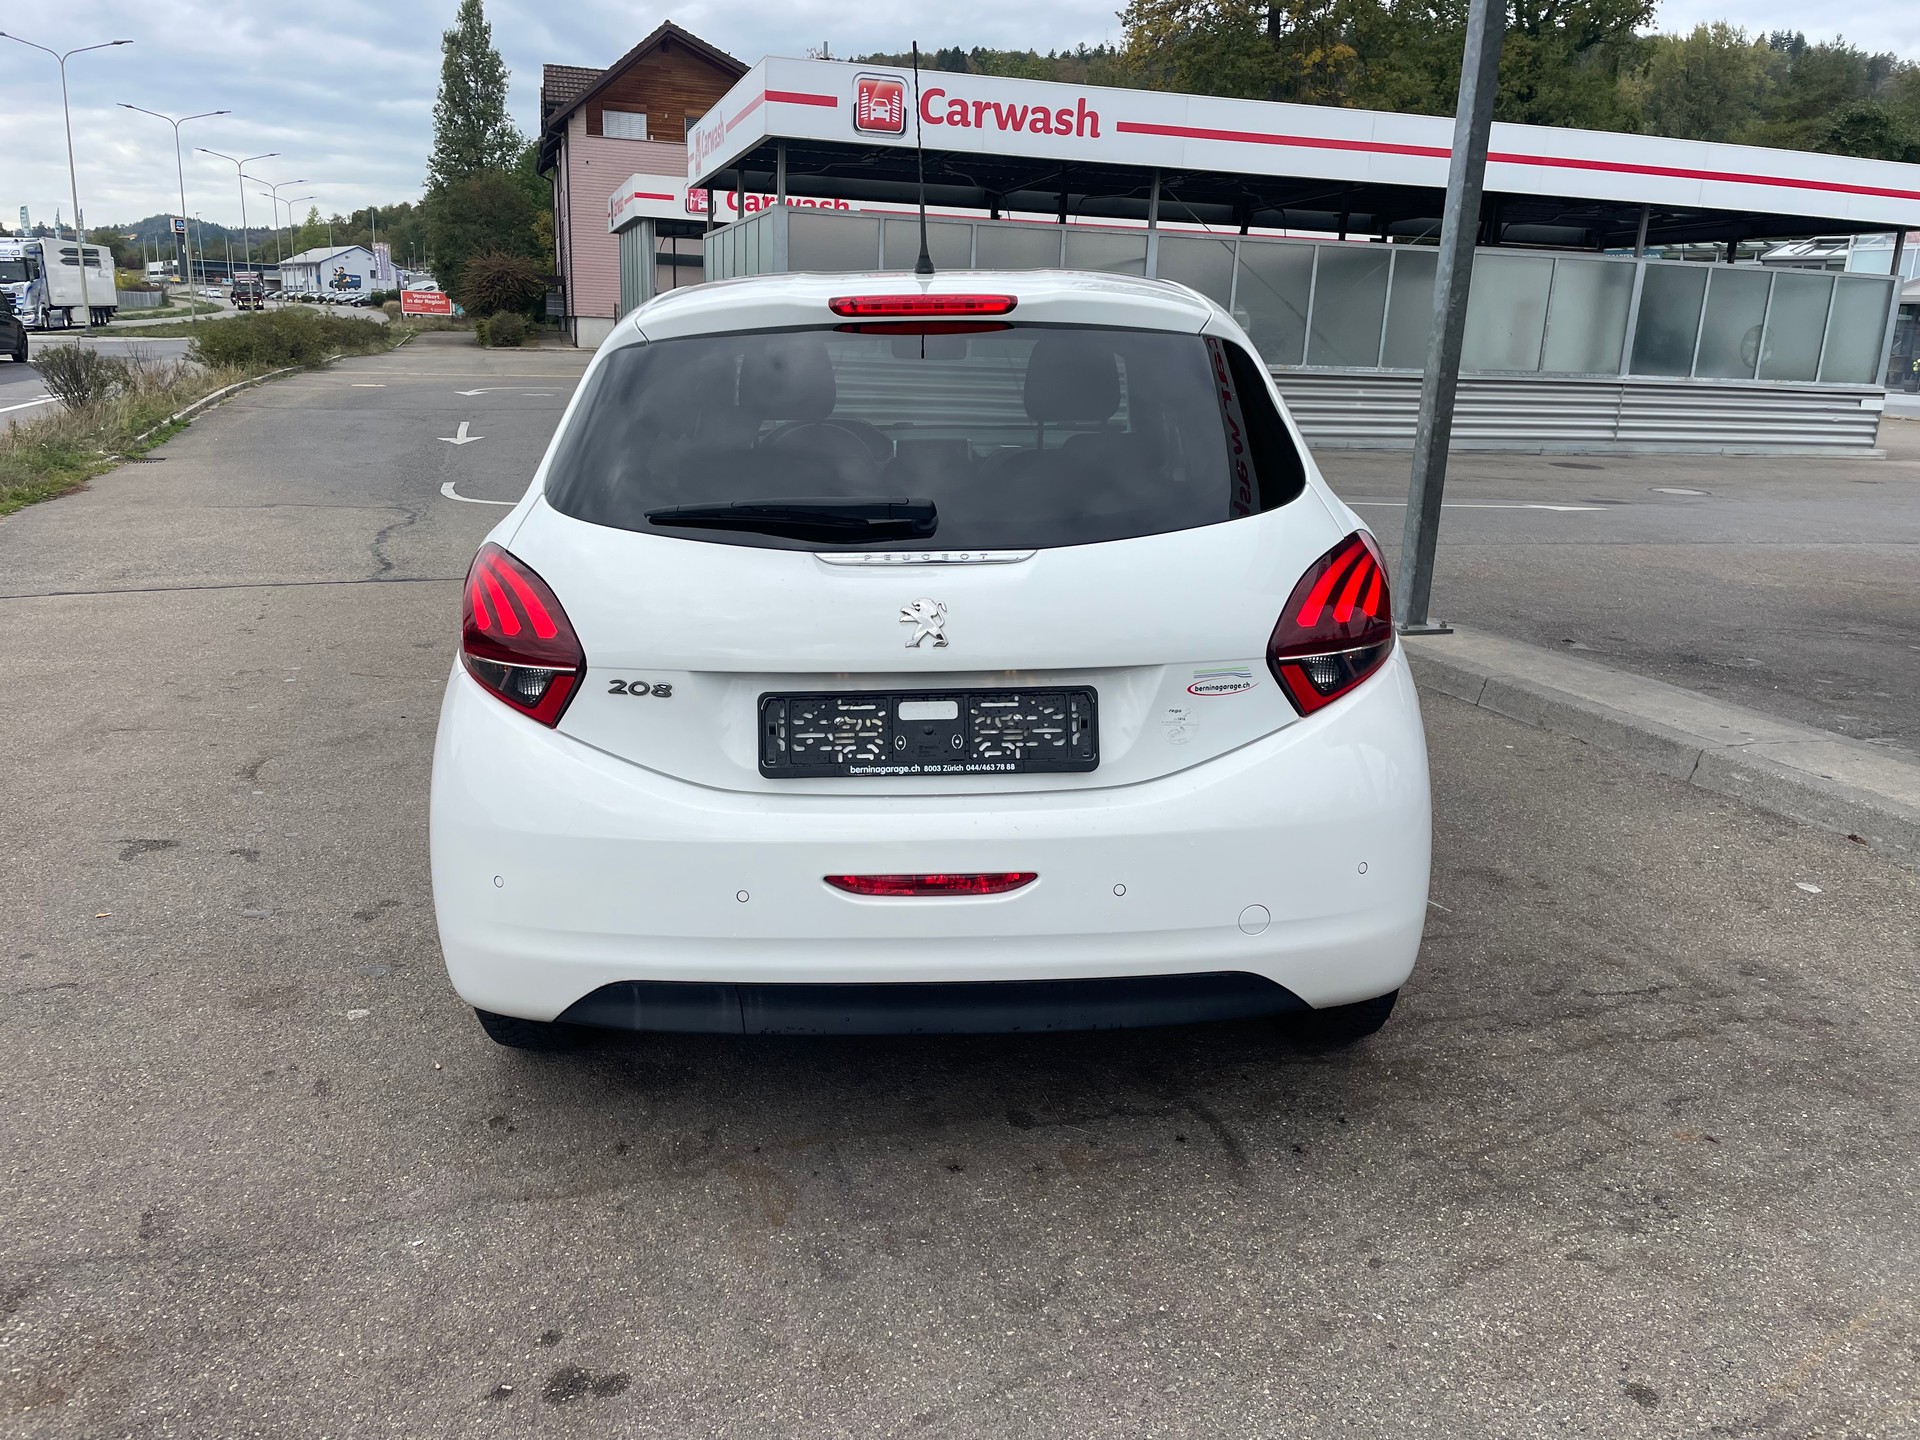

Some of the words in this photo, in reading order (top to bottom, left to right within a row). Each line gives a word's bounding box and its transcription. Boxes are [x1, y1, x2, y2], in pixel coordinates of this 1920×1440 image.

[920, 88, 1101, 138] Carwash
[864, 553, 988, 562] PEUGEOT
[607, 679, 673, 698] 208
[1194, 682, 1251, 692] berninagarage.ch
[849, 764, 921, 775] berninagarage.ch
[923, 765, 942, 773] 8003
[942, 764, 964, 773] Zürich
[965, 763, 995, 772] 044/463
[995, 763, 1006, 771] 78
[1006, 763, 1016, 771] 88
